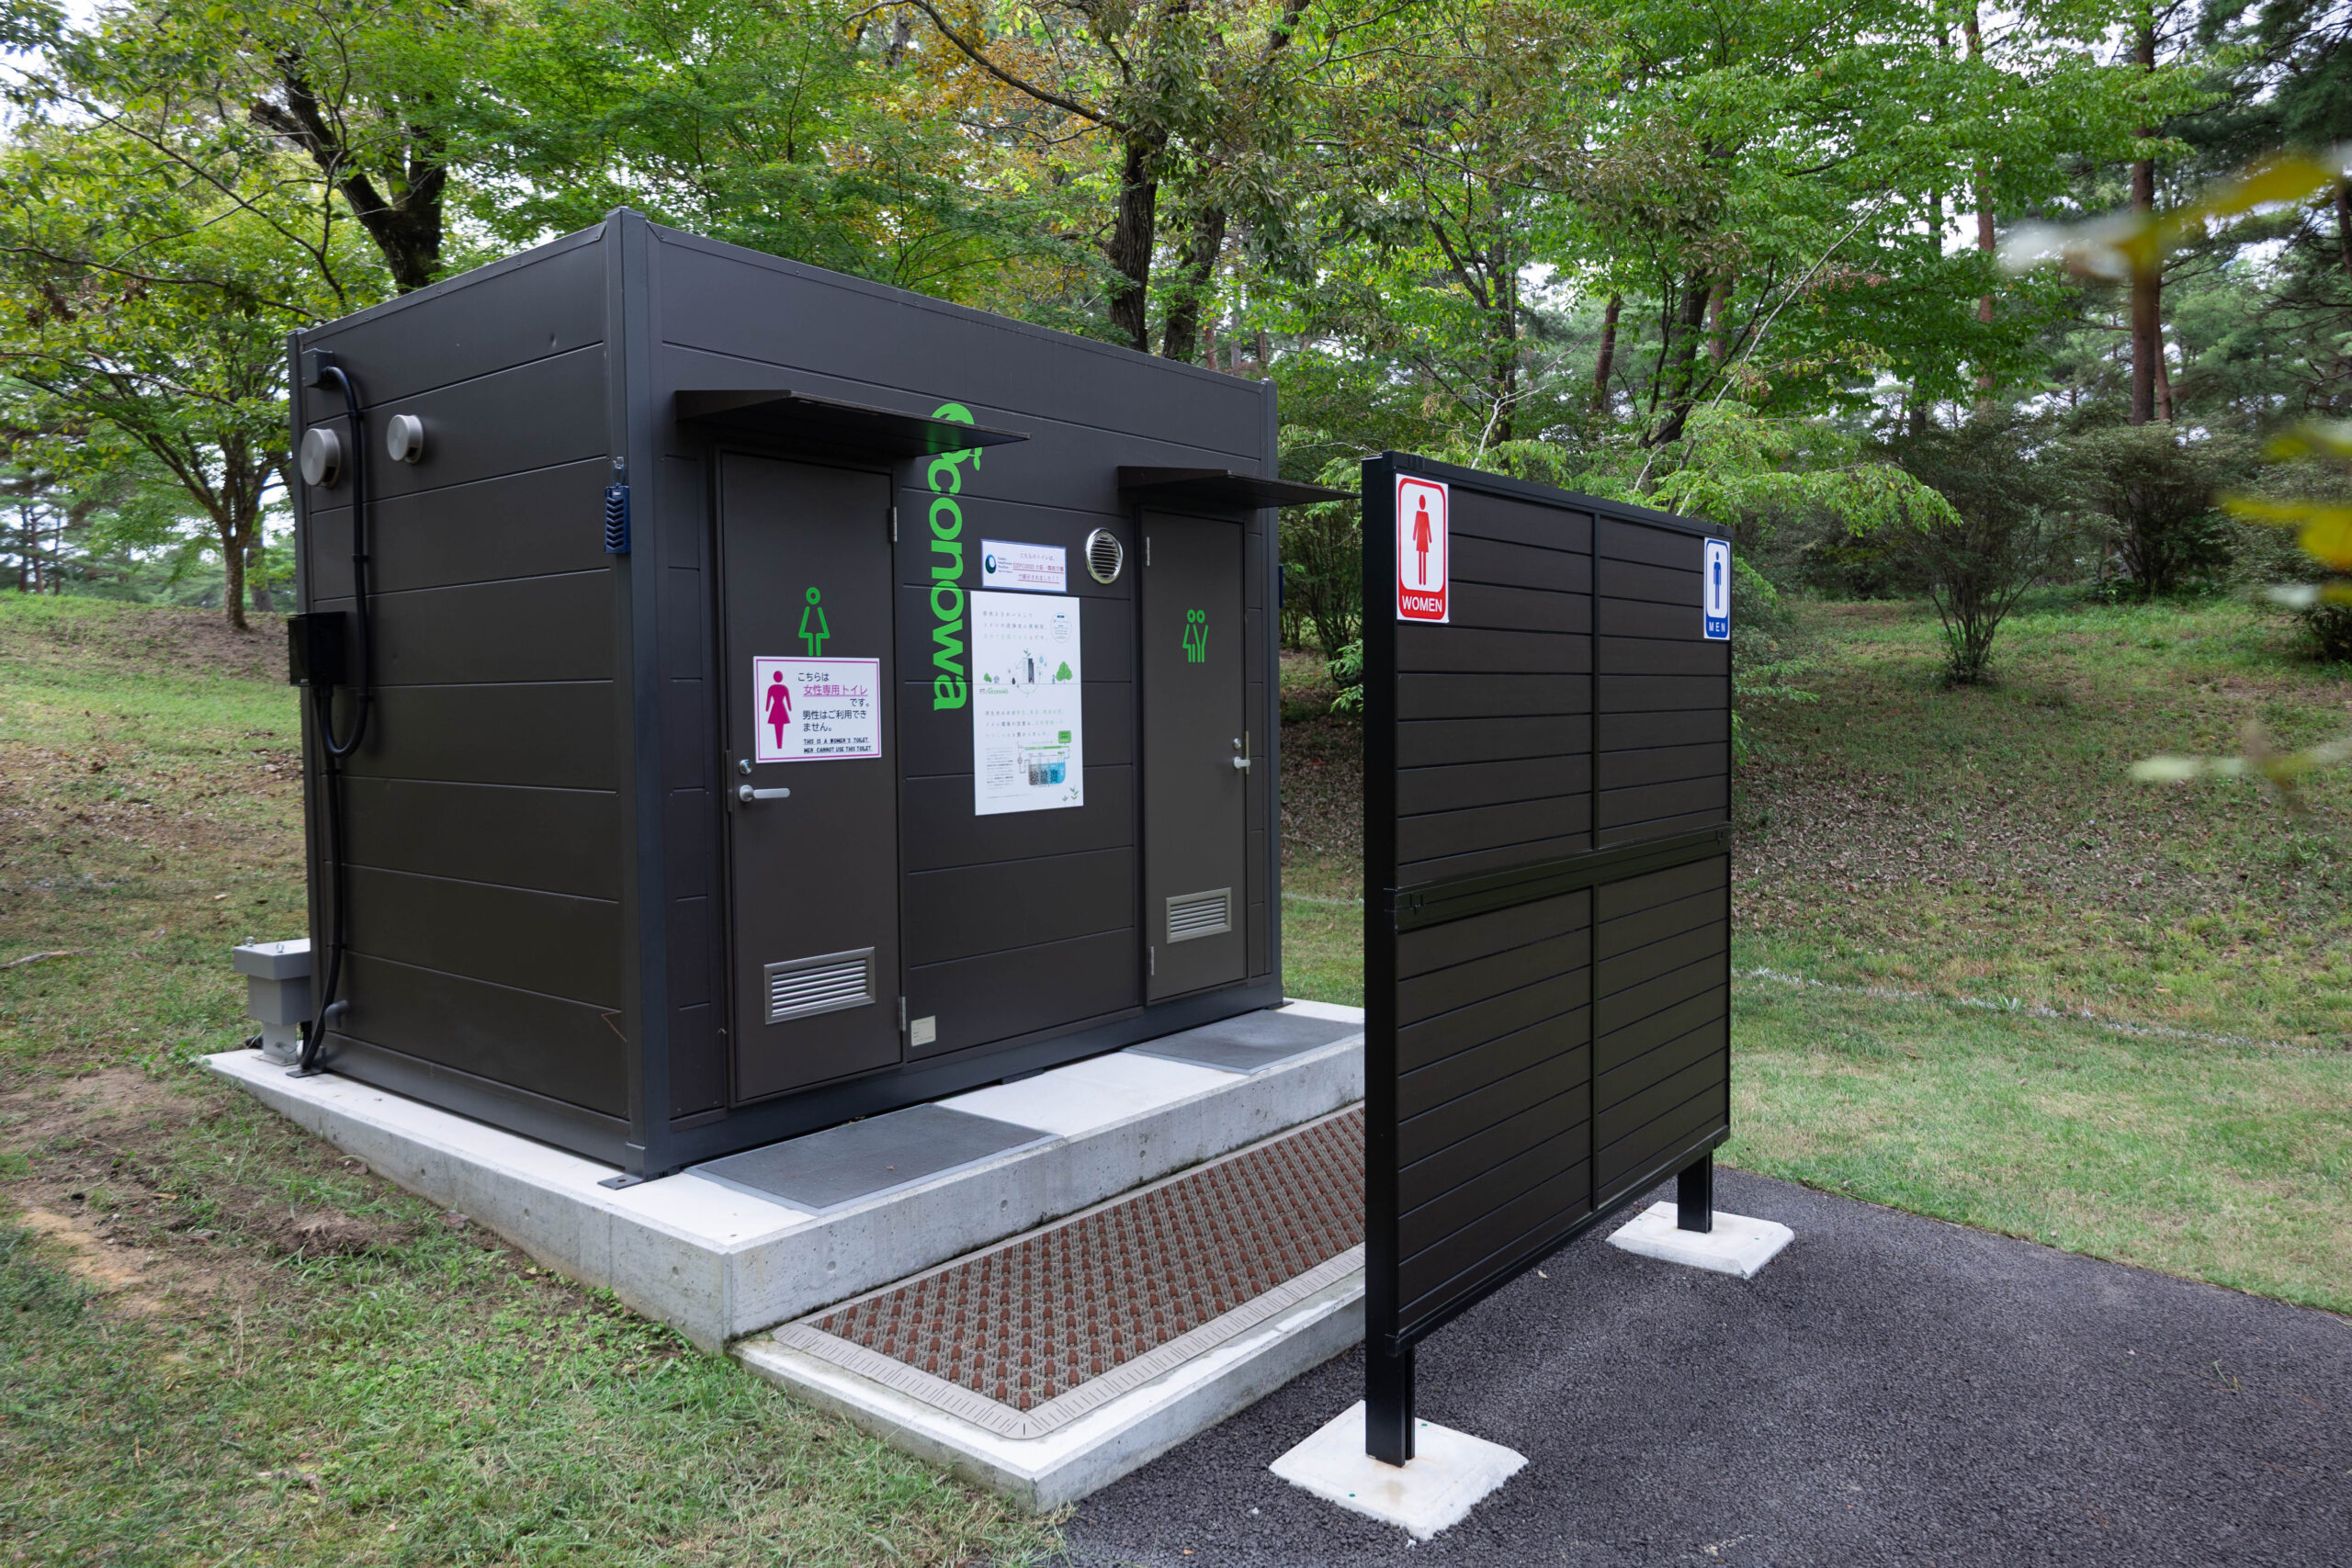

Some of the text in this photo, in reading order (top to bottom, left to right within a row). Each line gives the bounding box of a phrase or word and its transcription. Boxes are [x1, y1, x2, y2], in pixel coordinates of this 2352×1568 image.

[1401, 595, 1442, 613] WOMEN
[1709, 621, 1726, 632] MEN
[797, 672, 830, 682] こちらは
[803, 684, 868, 696] 女性専用トイレ
[850, 698, 870, 707] です。
[802, 709, 867, 720] 男性はご利用でき
[803, 722, 832, 732] ません。
